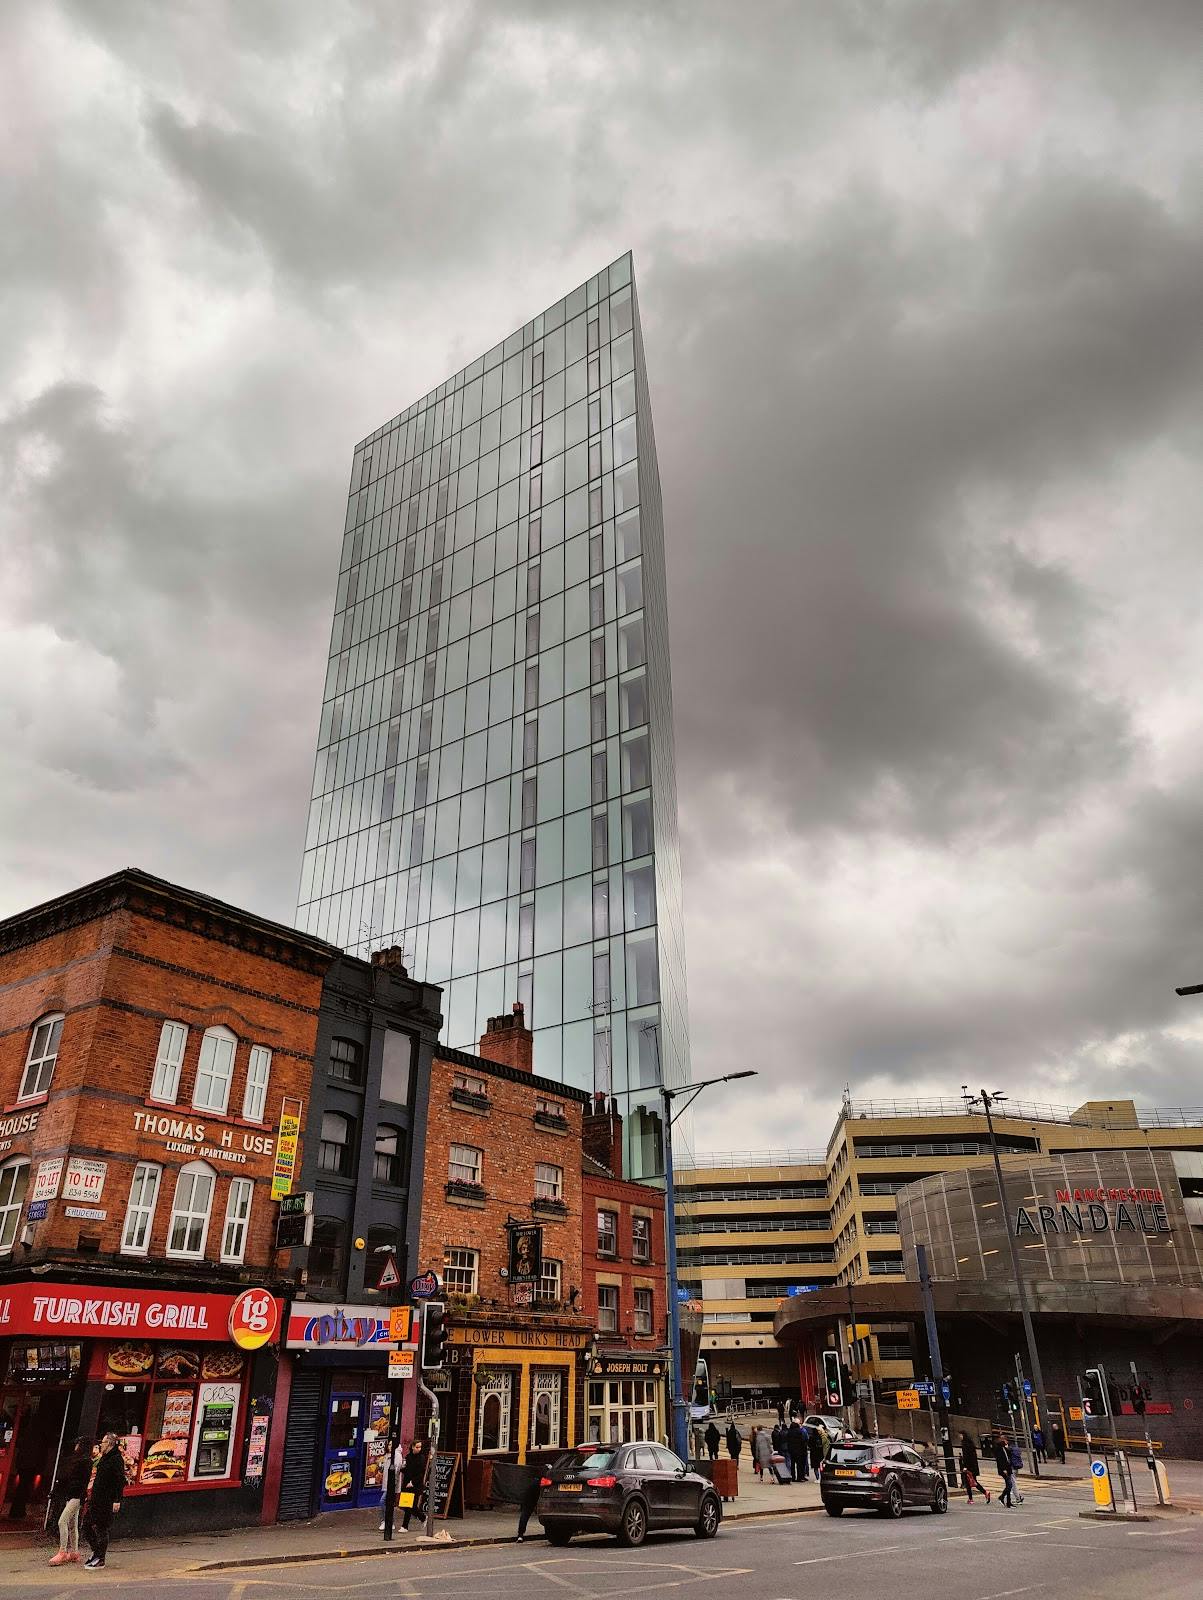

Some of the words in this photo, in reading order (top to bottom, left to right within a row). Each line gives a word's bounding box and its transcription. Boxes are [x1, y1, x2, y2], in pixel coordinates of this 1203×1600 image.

[133, 1112, 206, 1142] THOMAS
[166, 1141, 197, 1155] LUXURY
[199, 1147, 246, 1163] APARTMENTS
[38, 1174, 46, 1187] TO
[48, 1172, 60, 1185] LET
[69, 1172, 81, 1185] TO
[85, 1174, 101, 1188] LET
[1056, 1187, 1165, 1203] MANCHESTER
[66, 1208, 104, 1219] SHUDEHILL
[1015, 1203, 1171, 1236] ARNDALE
[32, 1296, 141, 1327] TURKISH
[145, 1303, 208, 1329] GRILL
[240, 1294, 270, 1331] tg
[465, 1329, 505, 1344] LOWER
[555, 1334, 581, 1347] HEAD
[607, 1363, 631, 1373] JOSEPH
[632, 1363, 648, 1373] HOLT
[369, 1441, 386, 1450] SNACK
